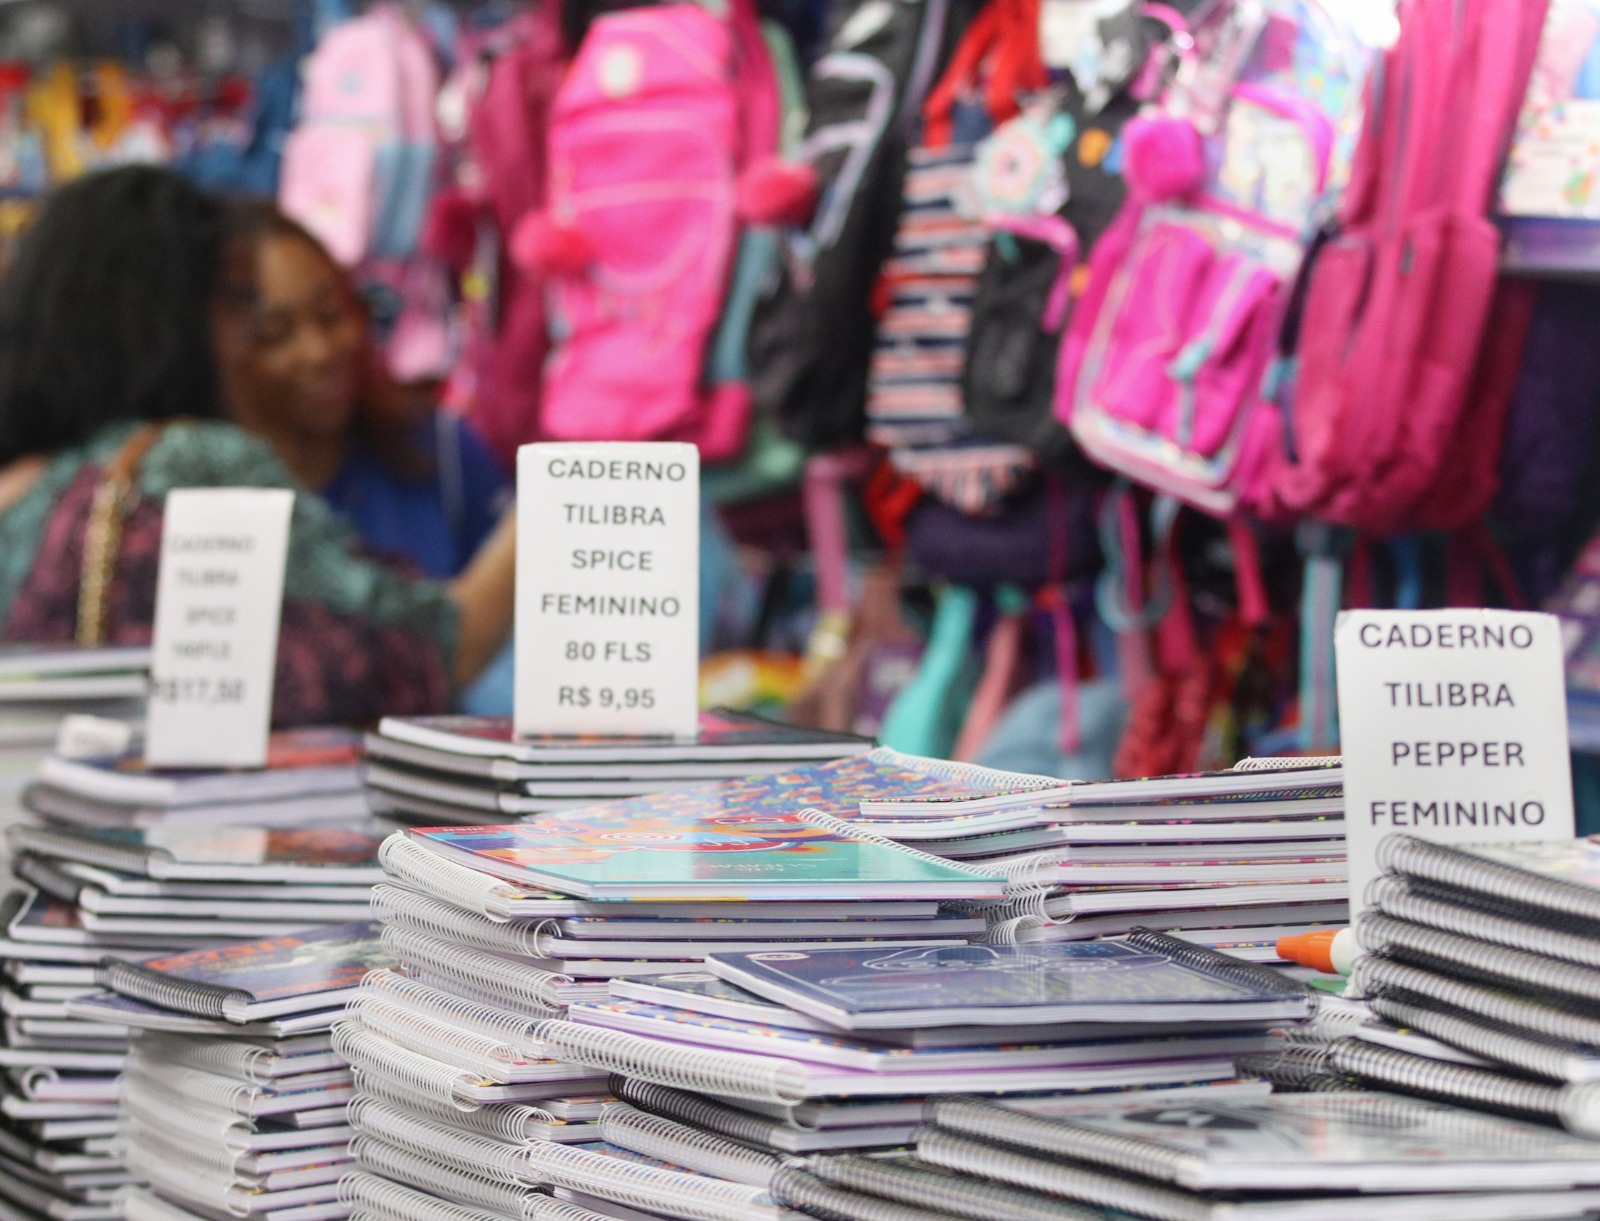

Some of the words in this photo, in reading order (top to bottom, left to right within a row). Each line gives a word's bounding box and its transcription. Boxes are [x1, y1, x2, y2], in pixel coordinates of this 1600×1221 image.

[547, 458, 687, 482] CADERNO
[563, 502, 666, 527] TILIBRA
[168, 534, 255, 556] CADERNO
[571, 548, 653, 572] SPICE
[541, 592, 680, 617] FEMININO
[1359, 622, 1534, 650] CADERNO
[564, 639, 597, 662] 80
[603, 640, 652, 663] FLS
[558, 685, 592, 709] R$
[598, 686, 656, 711] 9,95
[1384, 682, 1515, 708] TILIBRA
[1391, 741, 1526, 767] PEPPER
[1370, 800, 1546, 827] FEMININO
